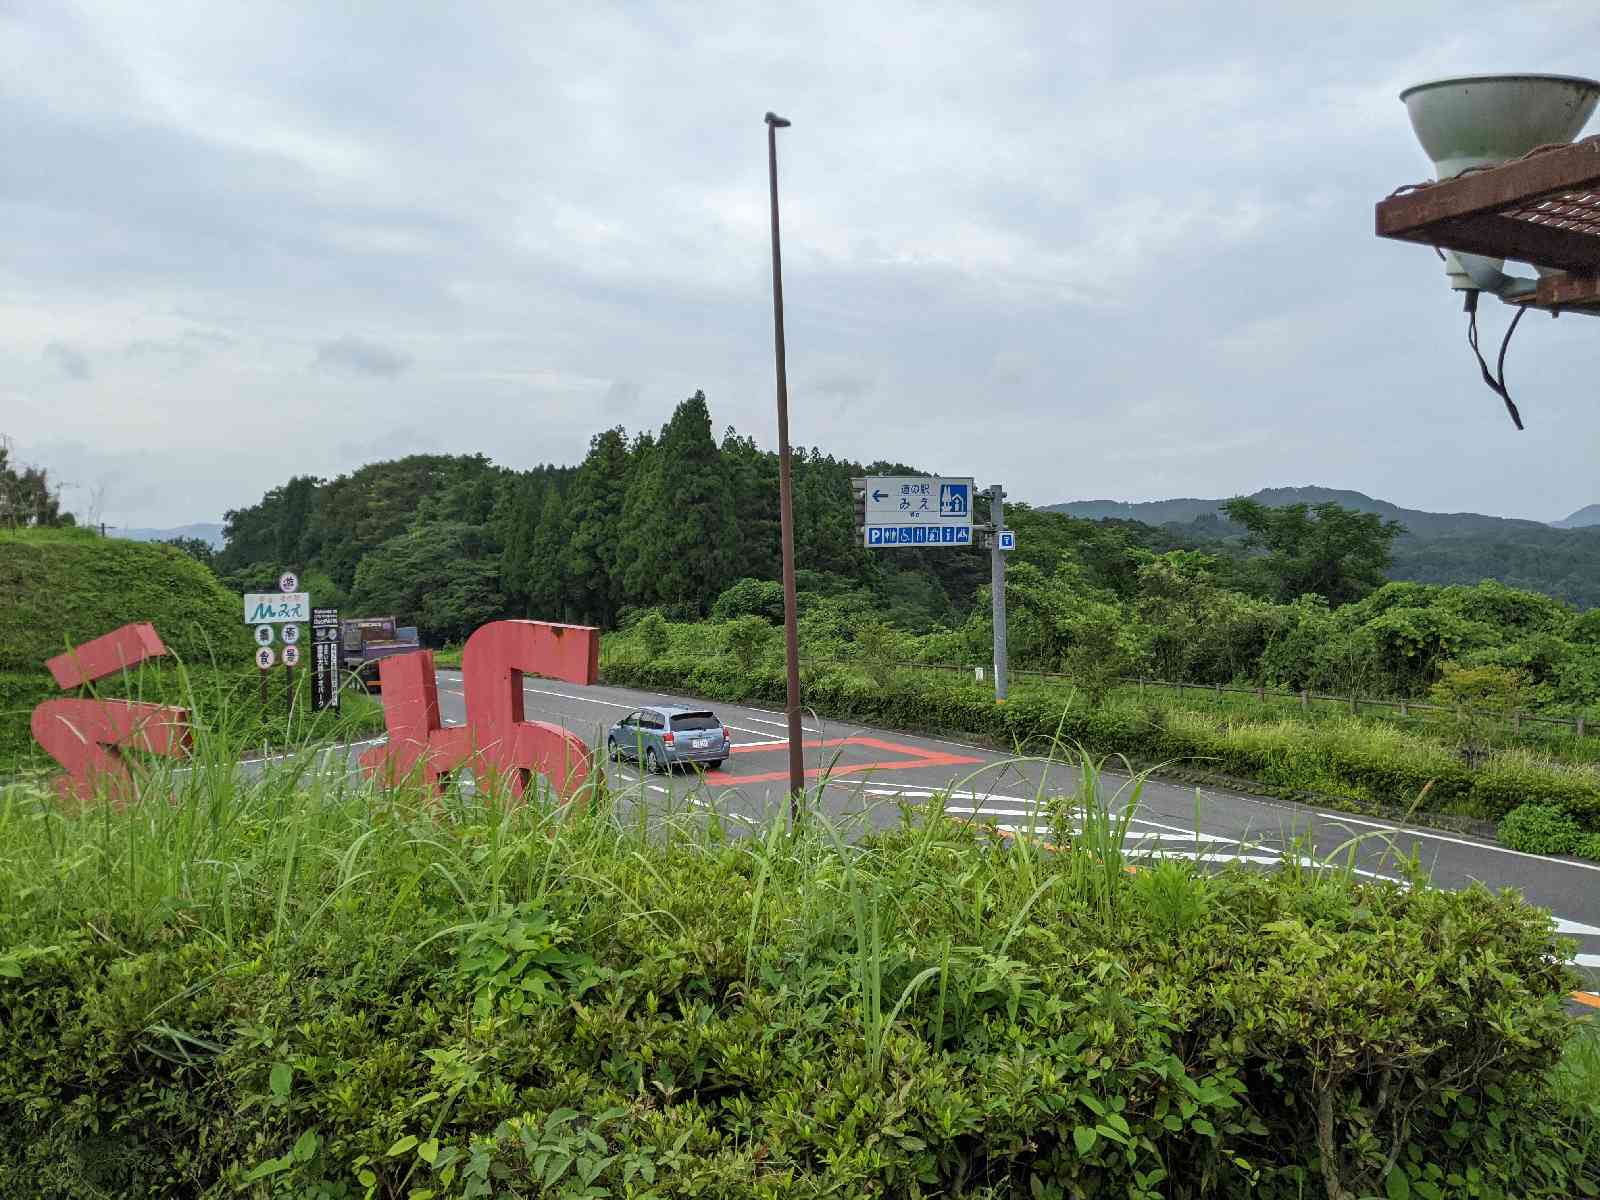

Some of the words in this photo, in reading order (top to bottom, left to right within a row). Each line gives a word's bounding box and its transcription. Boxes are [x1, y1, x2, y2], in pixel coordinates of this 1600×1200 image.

[901, 483, 930, 495] 道の駅
[899, 497, 930, 511] みえ
